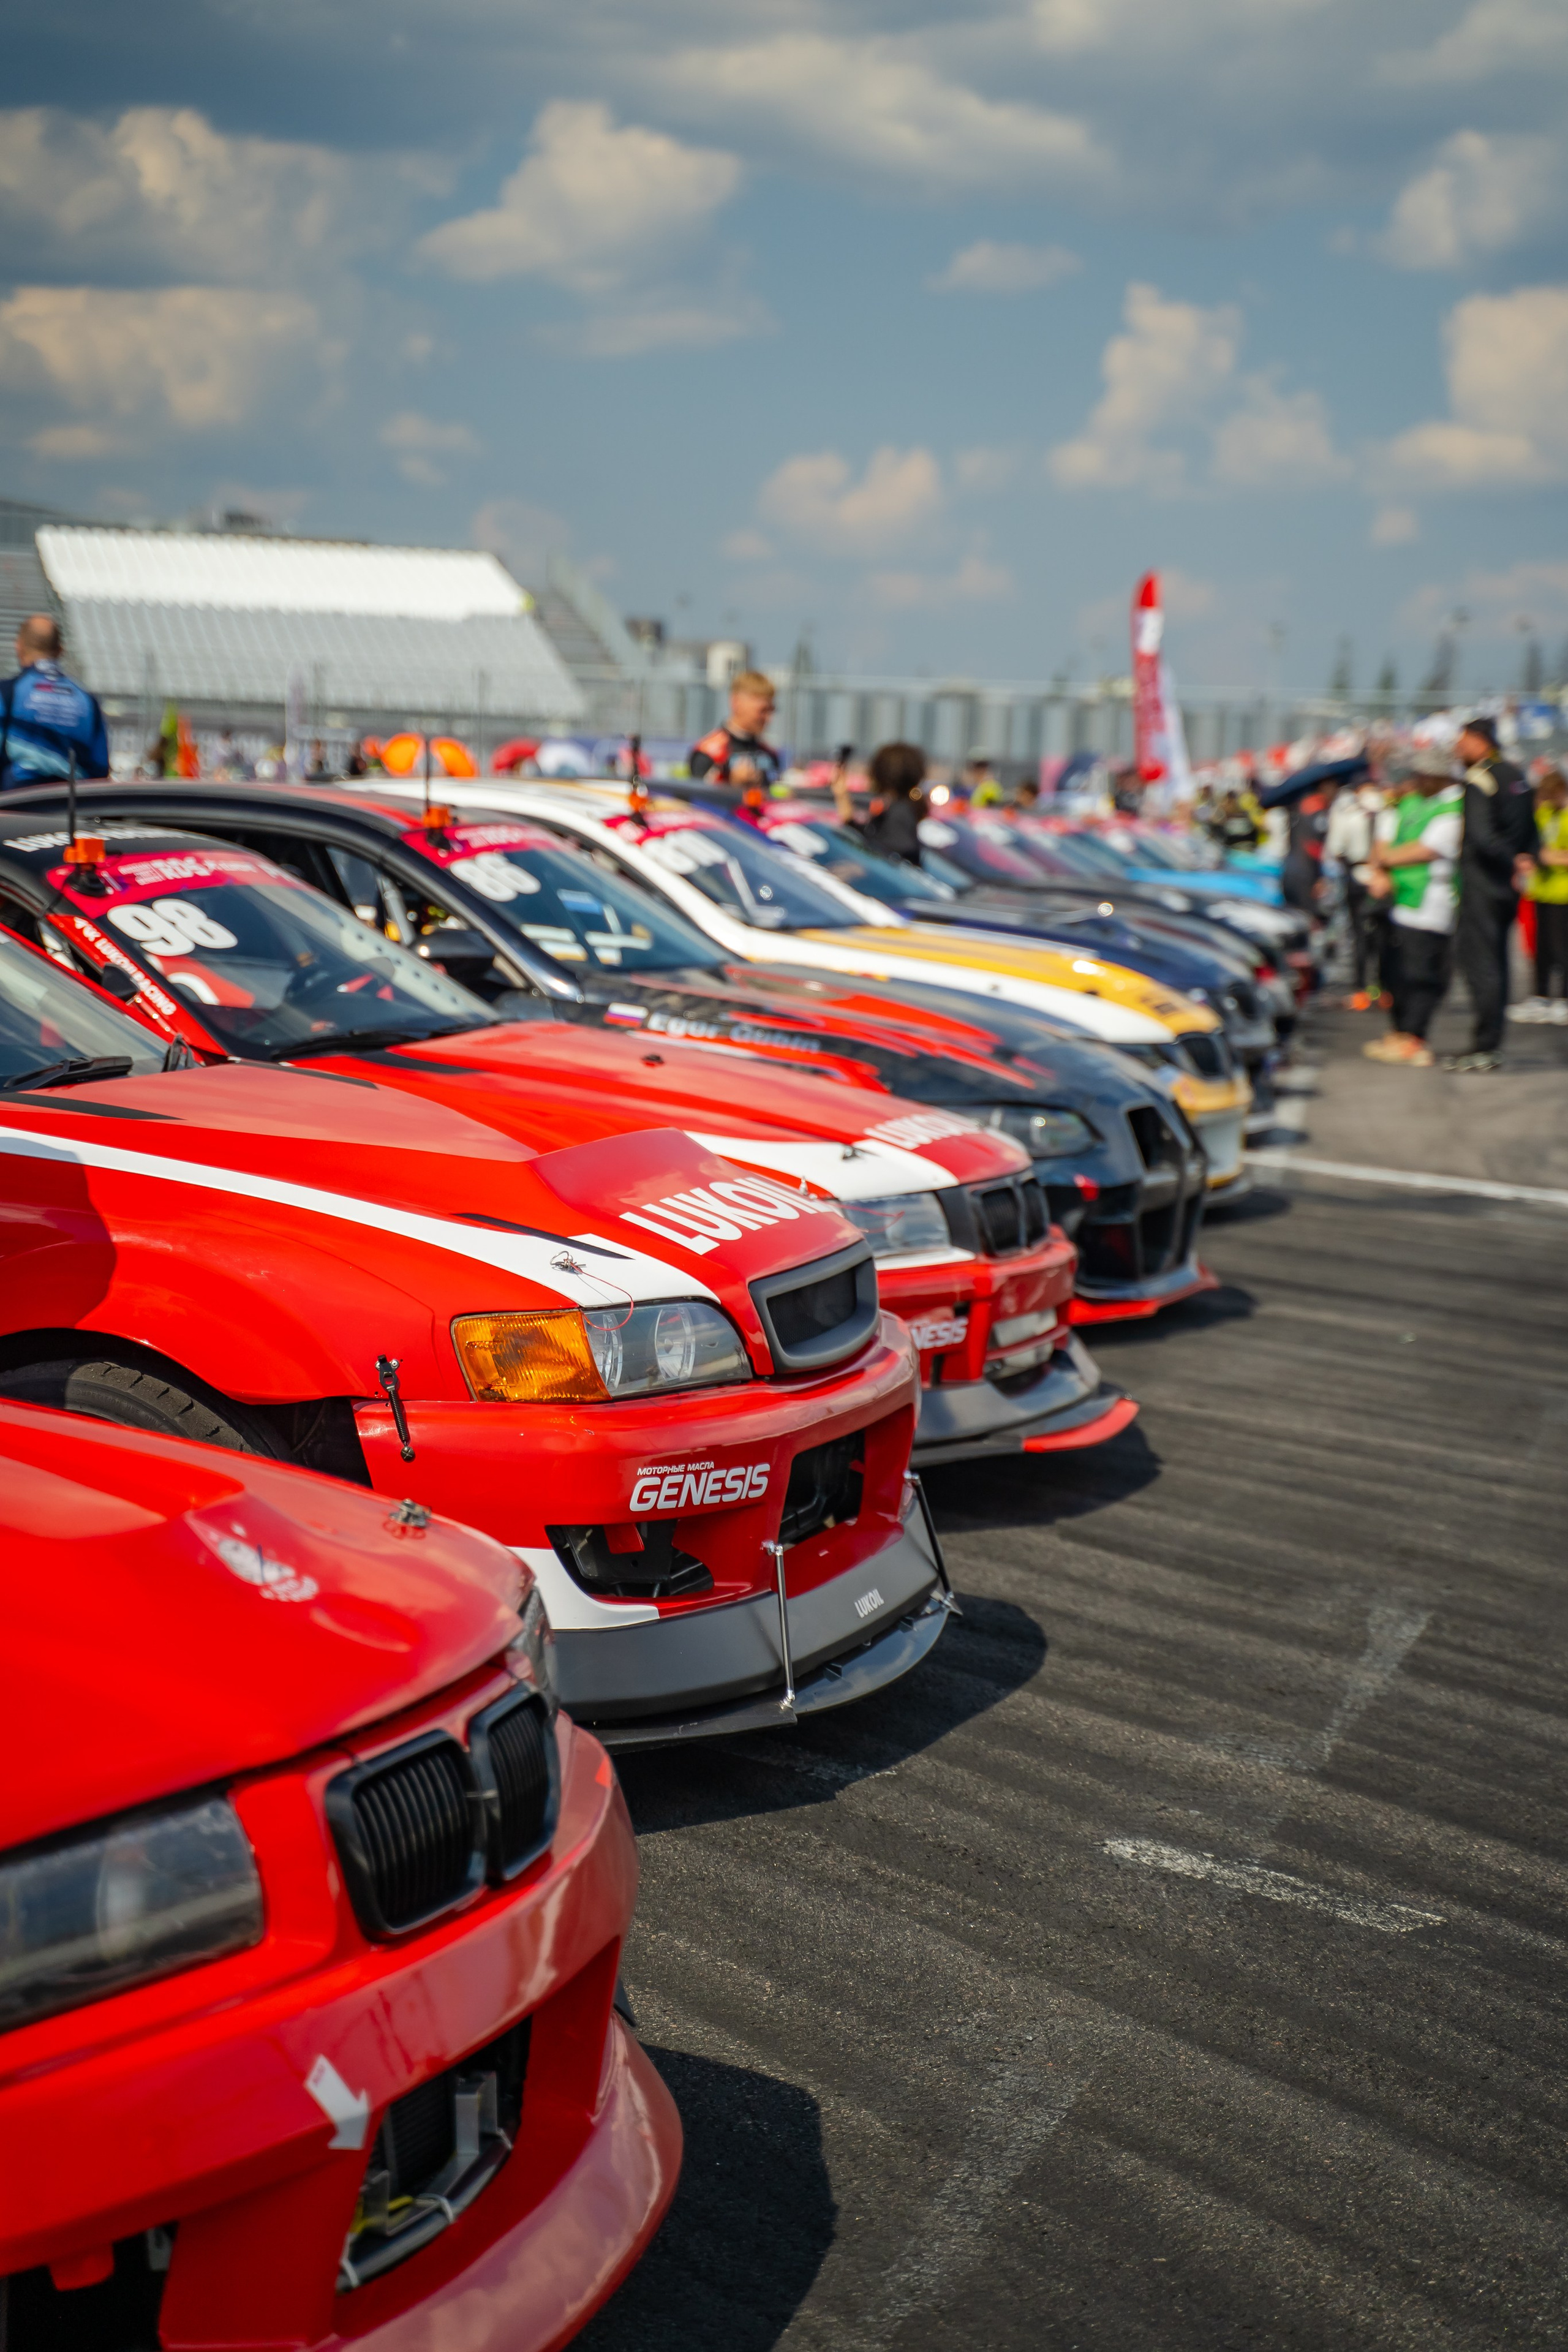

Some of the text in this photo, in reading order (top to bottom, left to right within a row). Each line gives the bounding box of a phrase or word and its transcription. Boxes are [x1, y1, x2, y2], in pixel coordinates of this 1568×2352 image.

[107, 899, 238, 956] 98
[132, 971, 177, 1016] RACING
[619, 1177, 835, 1255] LUKOIL
[630, 1464, 771, 1512] GENESIS
[637, 1461, 714, 1476] МОТОРНЫЕ МАСЛА
[854, 1589, 884, 1618] LUKOIL
